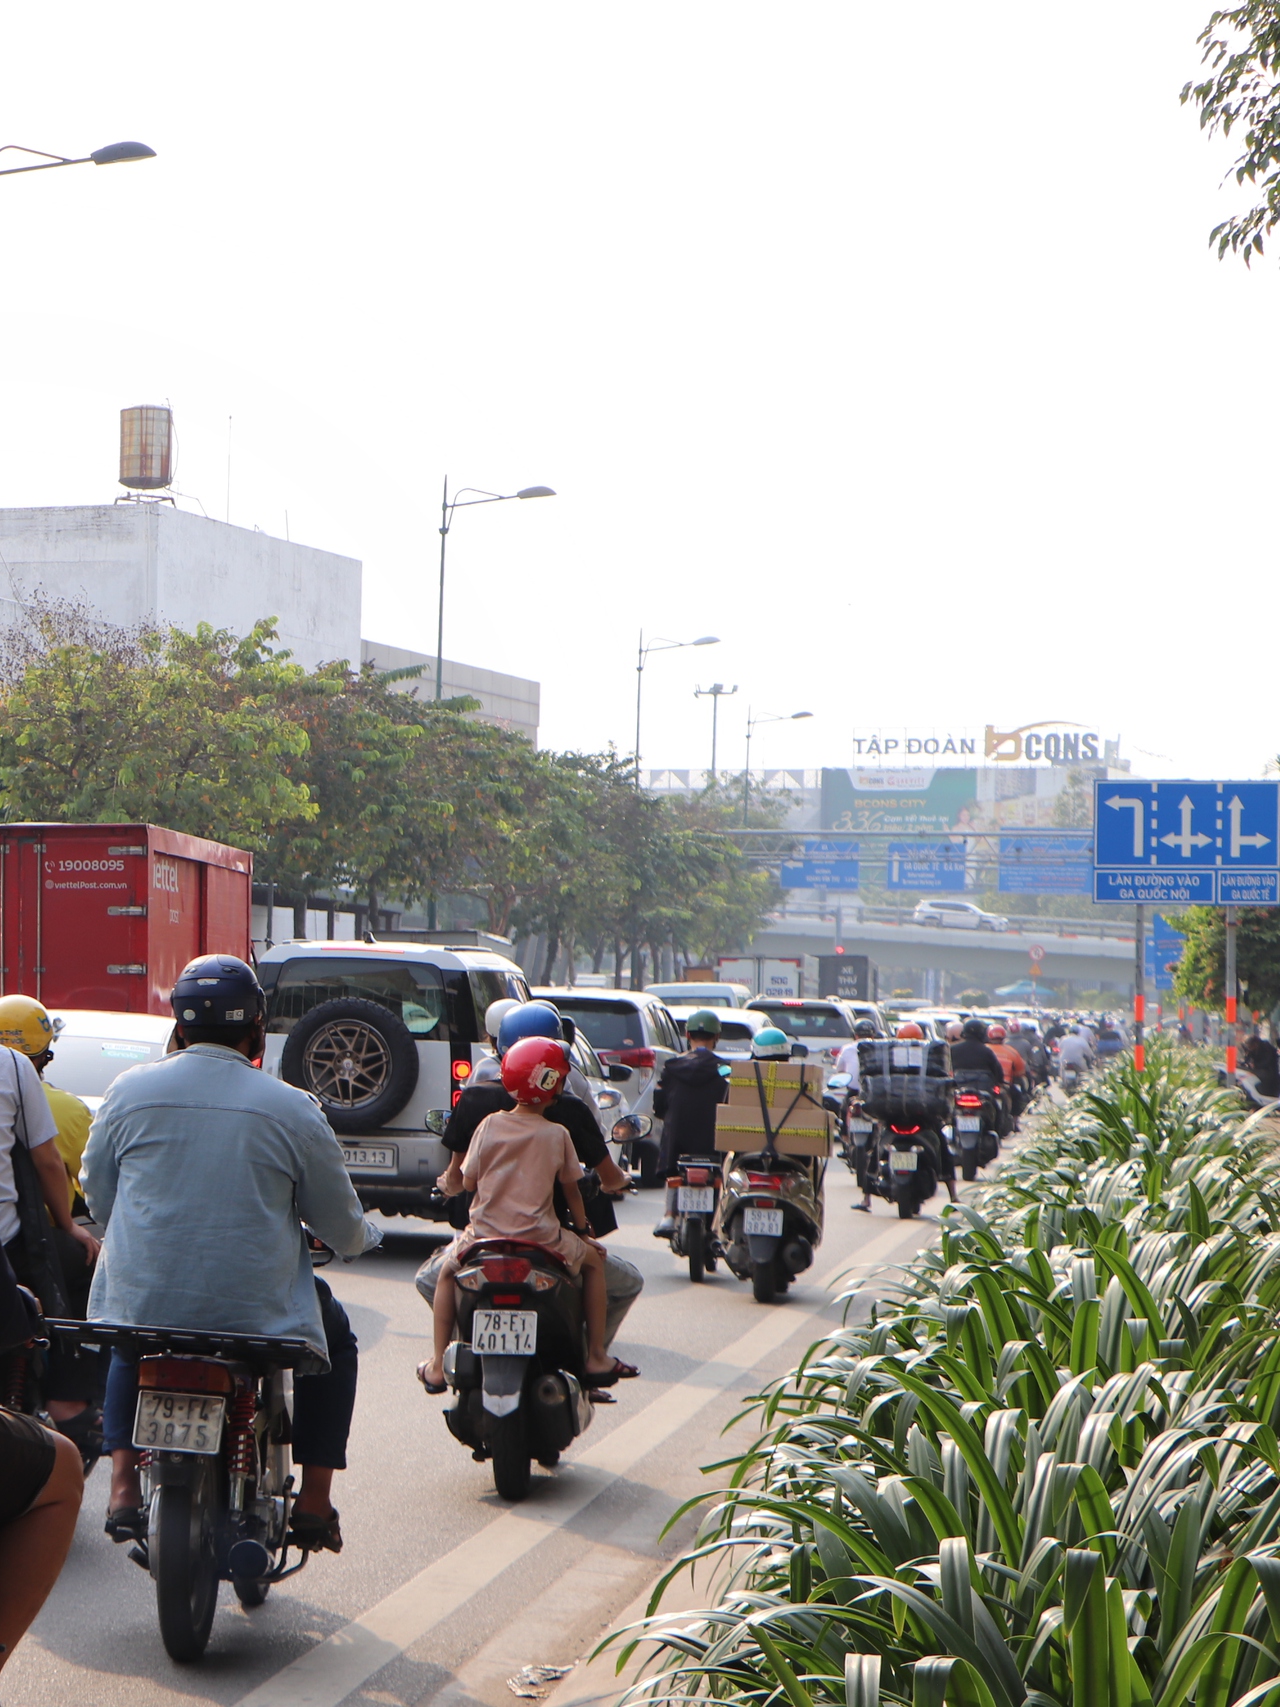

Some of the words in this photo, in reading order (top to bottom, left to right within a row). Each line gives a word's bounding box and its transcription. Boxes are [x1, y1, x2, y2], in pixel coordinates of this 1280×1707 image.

[853, 734, 899, 759] TẬP
[906, 733, 975, 755] ĐOÀN
[854, 799, 897, 809] BCONS
[899, 799, 927, 808] CITY
[58, 859, 125, 872] 19008095
[1108, 872, 1132, 886] LÀN
[1134, 872, 1175, 886] ĐƯỜNG
[1176, 872, 1200, 886] VÀO
[1221, 873, 1235, 886] LÀN
[1236, 873, 1261, 886] ĐƯỜNG
[1262, 873, 1276, 886] VÀO
[1119, 889, 1135, 899] GA
[1137, 886, 1169, 899] QUỐC
[1170, 886, 1190, 901] NỘI
[1231, 889, 1243, 900] GA
[840, 965, 854, 975] XE
[146, 1421, 207, 1448] 3875
